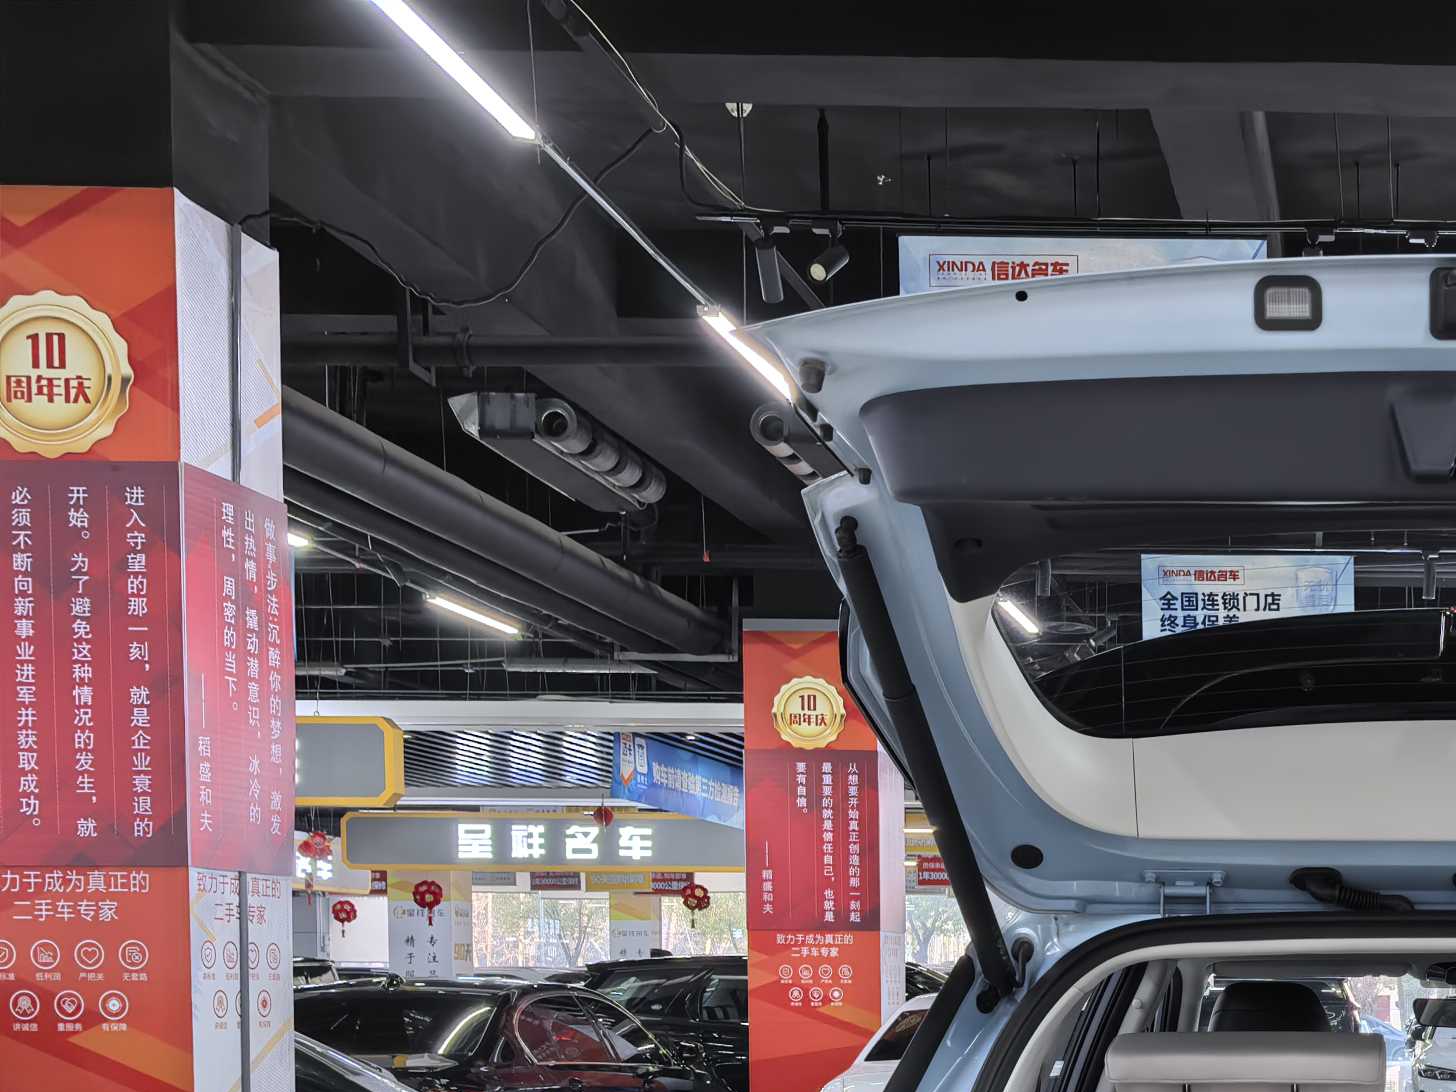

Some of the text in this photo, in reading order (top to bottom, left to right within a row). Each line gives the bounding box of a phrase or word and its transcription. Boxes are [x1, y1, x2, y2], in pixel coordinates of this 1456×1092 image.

[937, 260, 986, 273] XINDA
[26, 333, 66, 370] 10
[5, 376, 91, 405] 周年庆
[1193, 570, 1240, 582] 信达名车
[1160, 592, 1282, 612] 全国连锁门店
[799, 695, 817, 711] 10
[789, 713, 829, 727] 周年庆
[458, 823, 655, 860] 呈祥名车
[848, 762, 861, 923] 从想要开始真正创造的那一刻起
[1, 870, 149, 892] 力于成为真正的
[197, 873, 281, 899] 致力于成真正的
[13, 899, 119, 922] 二手车专家
[776, 933, 854, 945] 致力于成为真正的
[791, 947, 840, 957] 二手车专家
